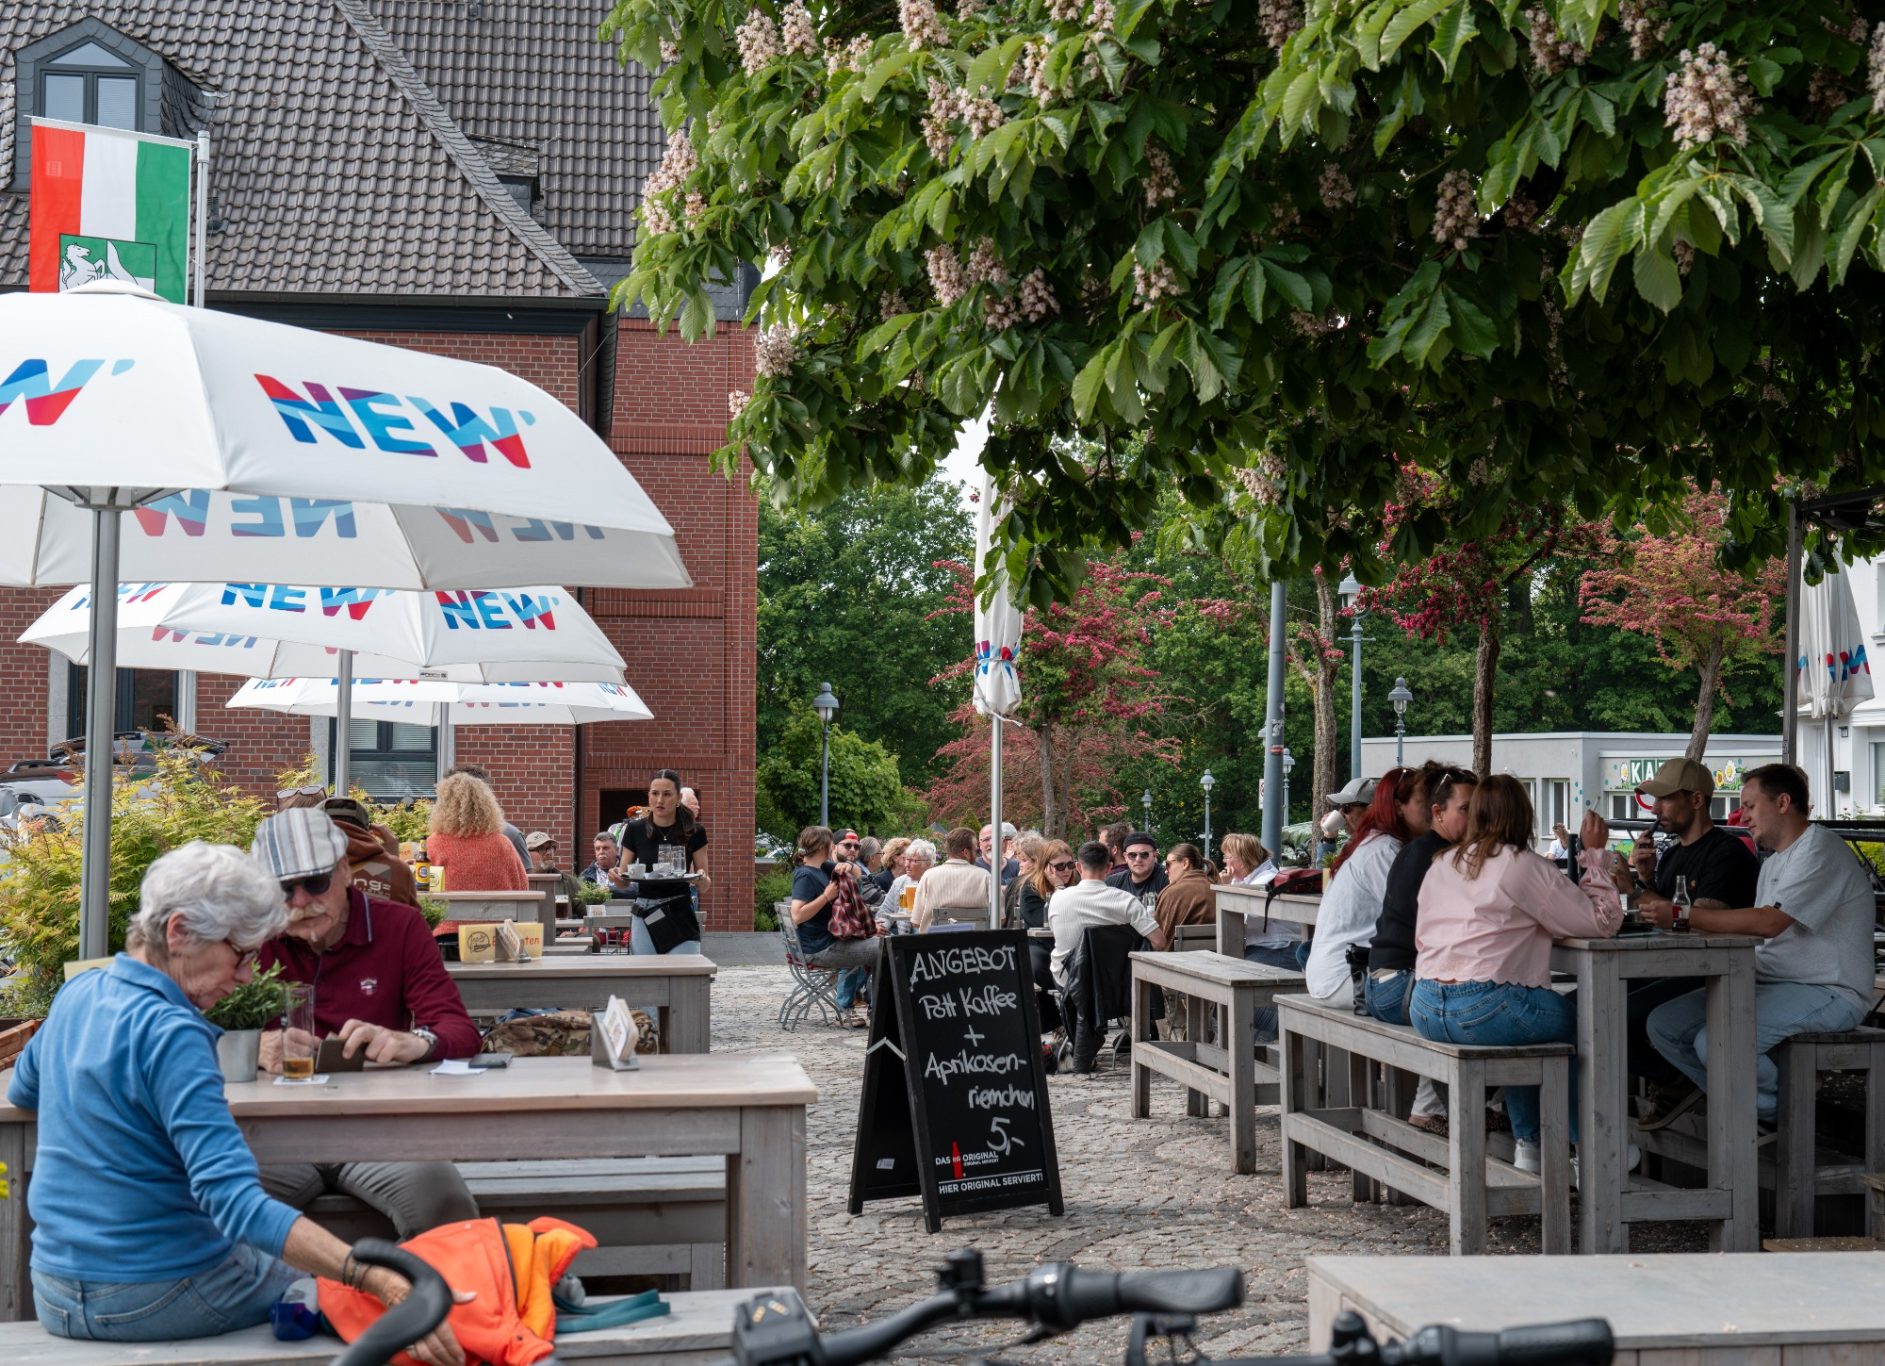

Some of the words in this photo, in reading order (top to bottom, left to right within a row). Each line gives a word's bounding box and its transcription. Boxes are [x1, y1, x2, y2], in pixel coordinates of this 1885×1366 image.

[254, 373, 532, 469] NEW
[435, 591, 556, 630] NEW
[909, 945, 1016, 984] ANGEBOT
[919, 992, 957, 1020] Pott
[959, 985, 1017, 1017] Kaffee
[935, 1156, 951, 1166] DAS
[962, 1150, 999, 1163] ORIGINAL
[938, 1183, 960, 1195] HIER
[960, 1179, 1002, 1192] ORIGINAL
